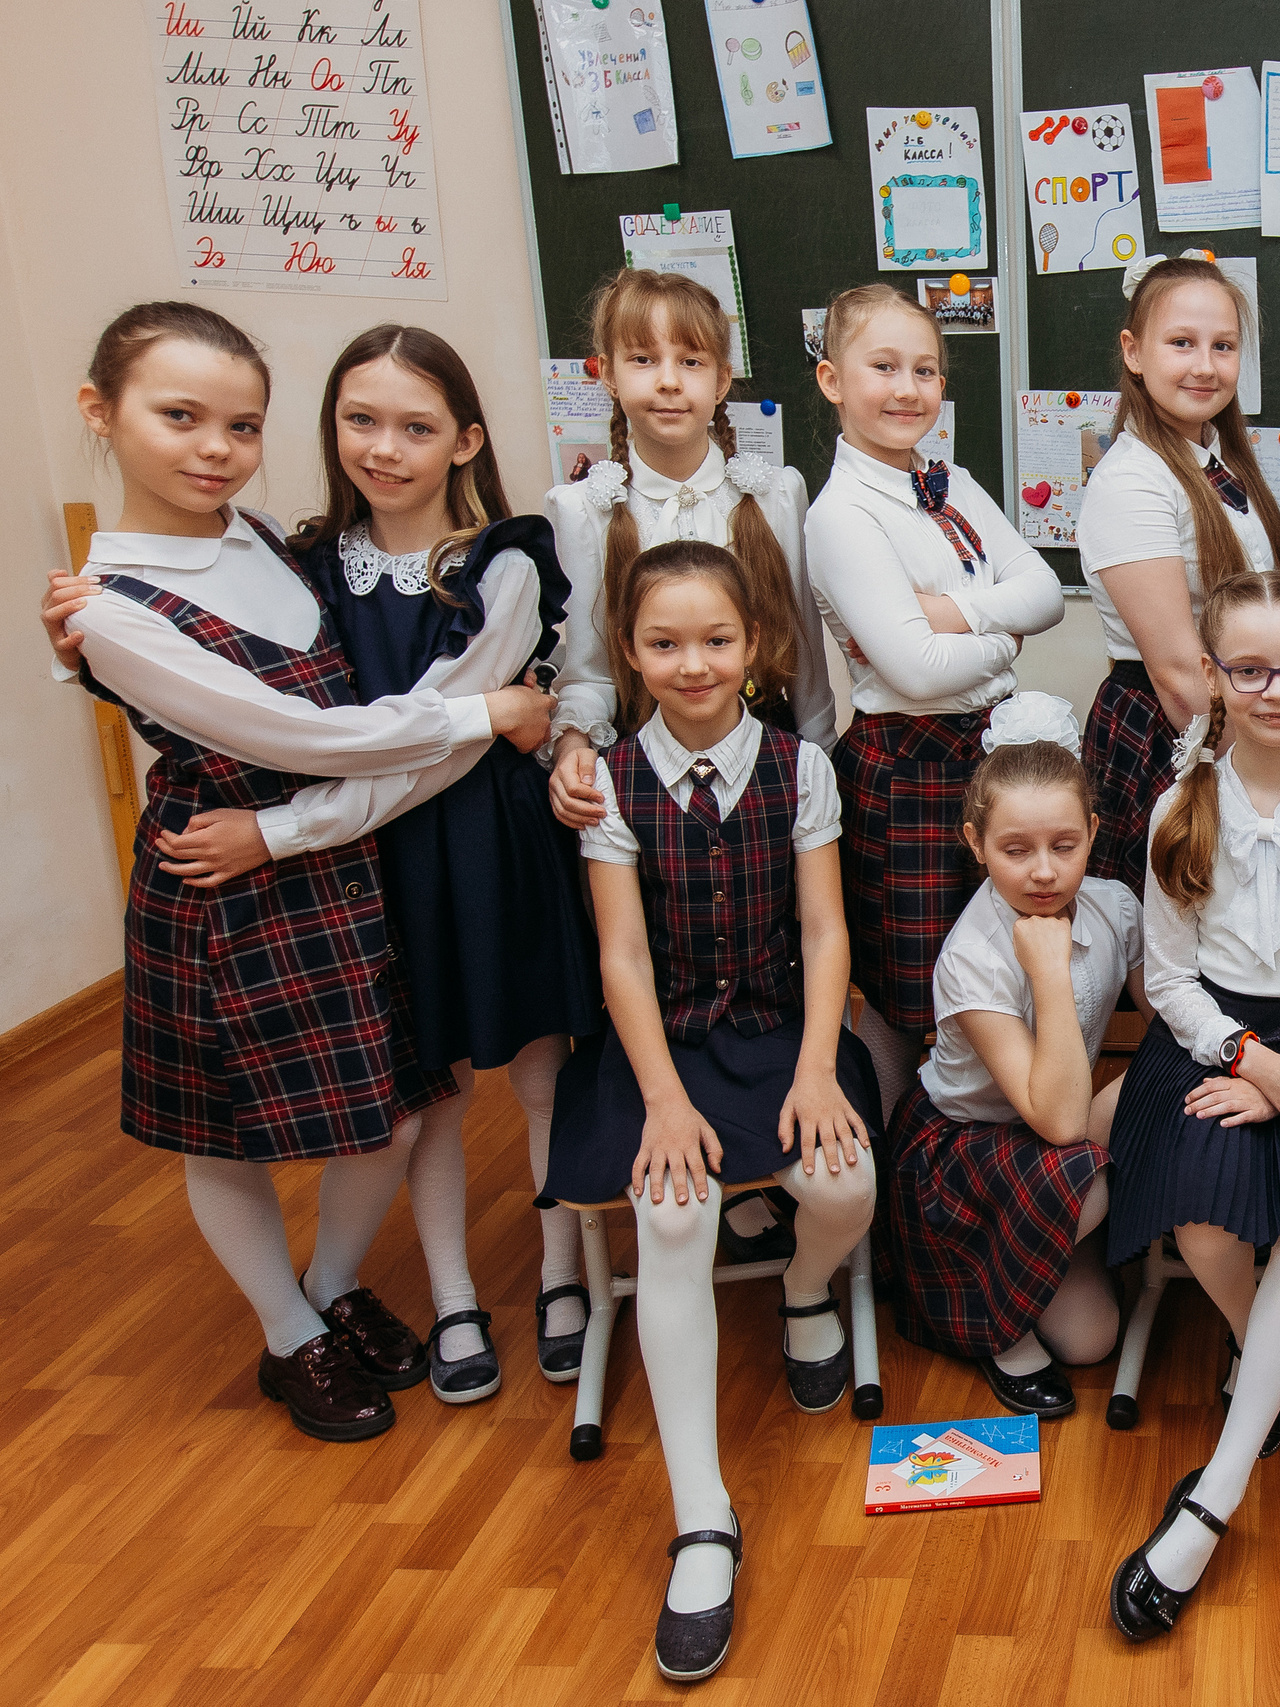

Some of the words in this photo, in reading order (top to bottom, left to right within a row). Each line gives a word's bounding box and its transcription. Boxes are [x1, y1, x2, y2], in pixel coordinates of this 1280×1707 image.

[165, 2, 205, 36] Ии
[232, 0, 271, 40] Йй
[297, 9, 337, 43] Кк
[361, 13, 407, 47] Лл
[167, 51, 229, 86] Мм
[248, 54, 292, 88] Нн
[311, 57, 345, 91] Оо
[363, 60, 413, 95] Пп
[603, 70, 612, 88] Б
[171, 97, 210, 144] Рр
[237, 100, 268, 134] Сс
[295, 104, 360, 139] Тт
[387, 108, 420, 155] Уу
[180, 145, 223, 190] Фф
[241, 147, 295, 182] Хх
[316, 151, 360, 192] Цц
[381, 154, 416, 188] Чч
[1034, 170, 1133, 205] СПОРТ
[188, 190, 245, 225] Шш
[262, 194, 326, 235] Щщ
[339, 213, 361, 231] ъ
[376, 215, 397, 233] ы
[194, 236, 226, 267] Ээ
[284, 241, 336, 273] Юю
[391, 247, 431, 279] Яя
[945, 1435, 1002, 1468] Математика
